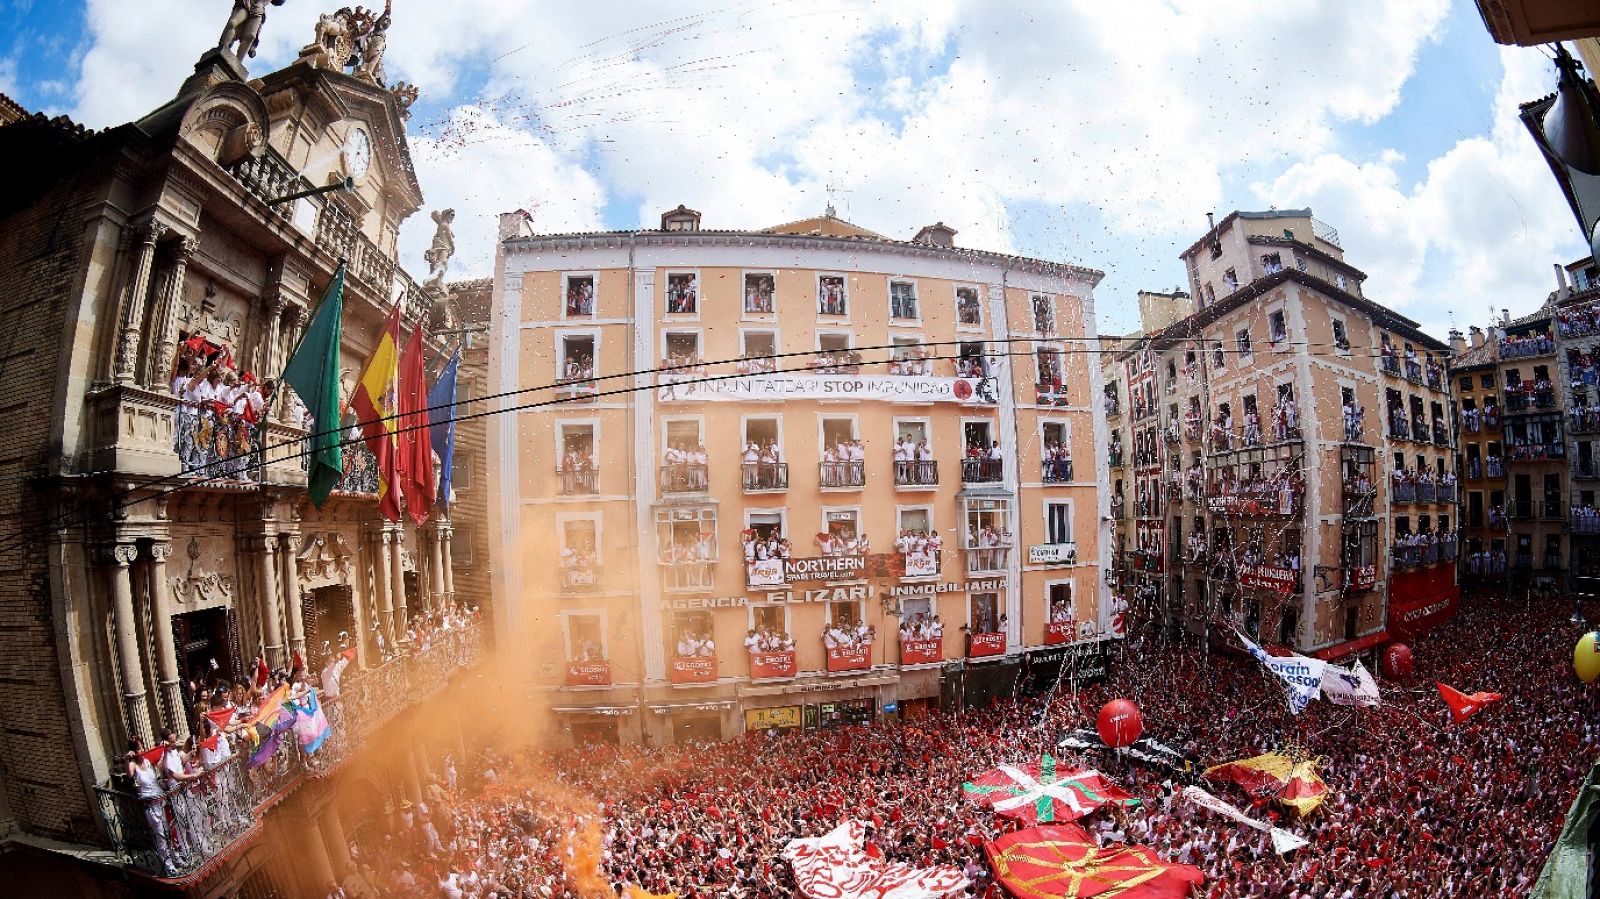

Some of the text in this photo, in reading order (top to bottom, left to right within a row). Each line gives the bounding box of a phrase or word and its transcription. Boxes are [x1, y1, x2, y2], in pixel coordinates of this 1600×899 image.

[823, 380, 863, 393] STOP
[785, 557, 865, 573] NORTHERN
[767, 585, 875, 604] ELIZARI
[890, 579, 1008, 596] INMOBILIARIA
[661, 597, 749, 610] AGENCIA
